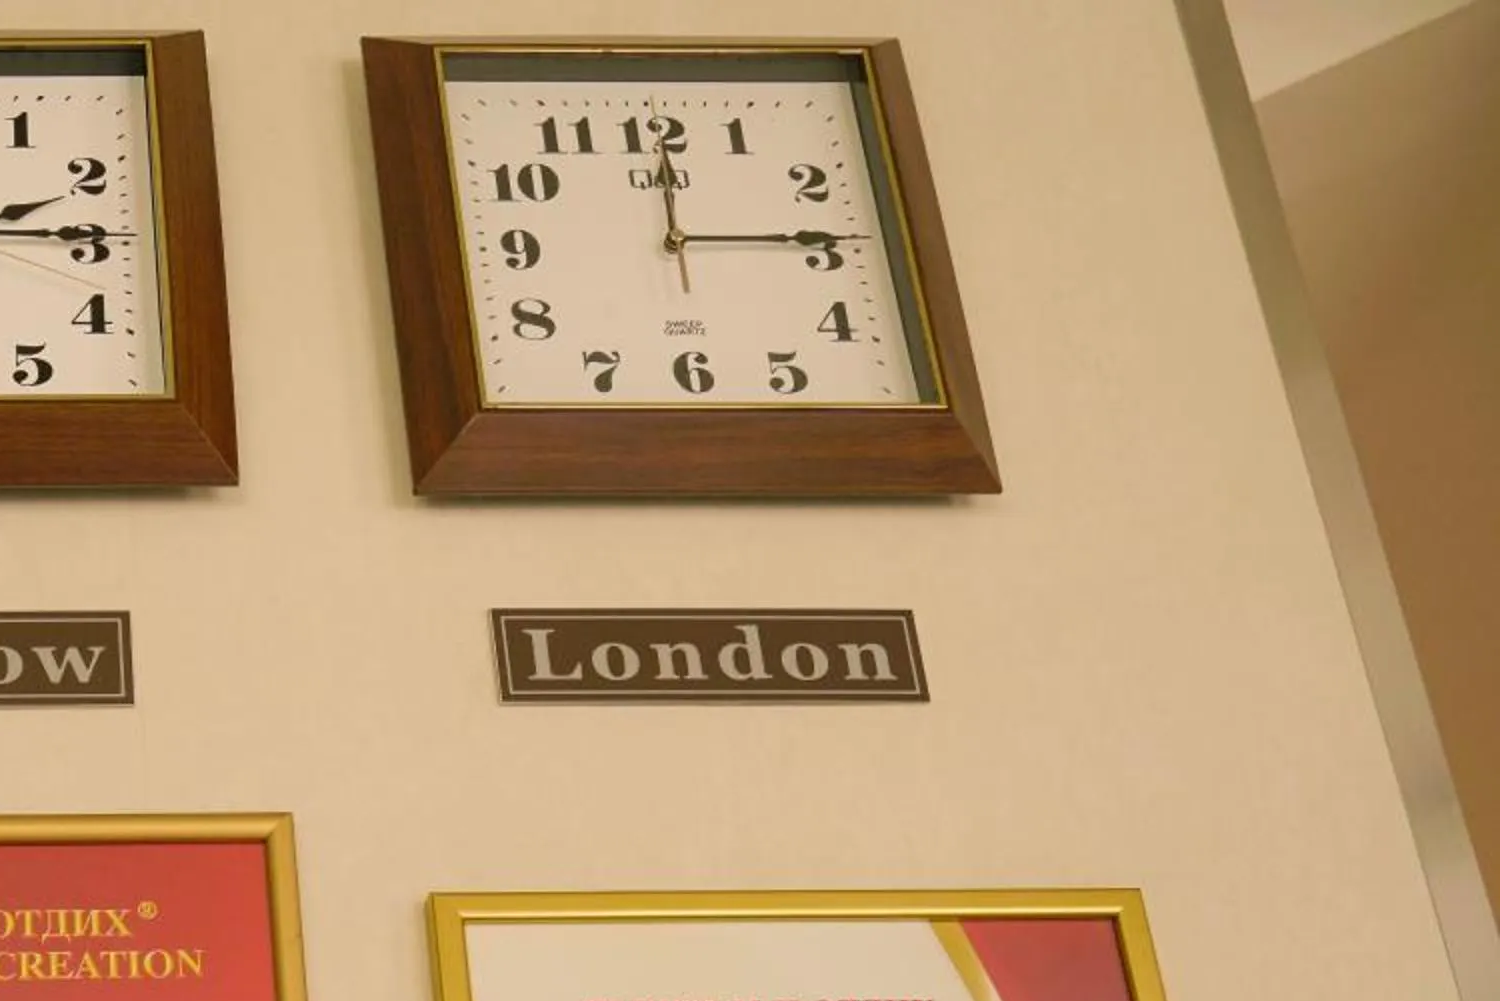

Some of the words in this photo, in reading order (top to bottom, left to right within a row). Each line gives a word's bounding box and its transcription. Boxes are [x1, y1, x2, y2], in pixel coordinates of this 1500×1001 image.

[4, 111, 37, 149] 1
[534, 116, 603, 155] 11
[615, 116, 688, 154] 12
[720, 117, 754, 155] 1
[67, 157, 107, 196] 2
[487, 163, 560, 203] 10
[788, 163, 829, 204] 2
[69, 223, 111, 265] 3
[500, 229, 541, 271] 9
[803, 230, 845, 273] 3
[70, 293, 114, 335] 4
[510, 298, 557, 341] 8
[816, 301, 860, 343] 4
[12, 343, 54, 387] 5
[582, 351, 620, 393] 7
[672, 351, 716, 394] 6
[767, 351, 809, 395] 5
[522, 624, 897, 681] London
